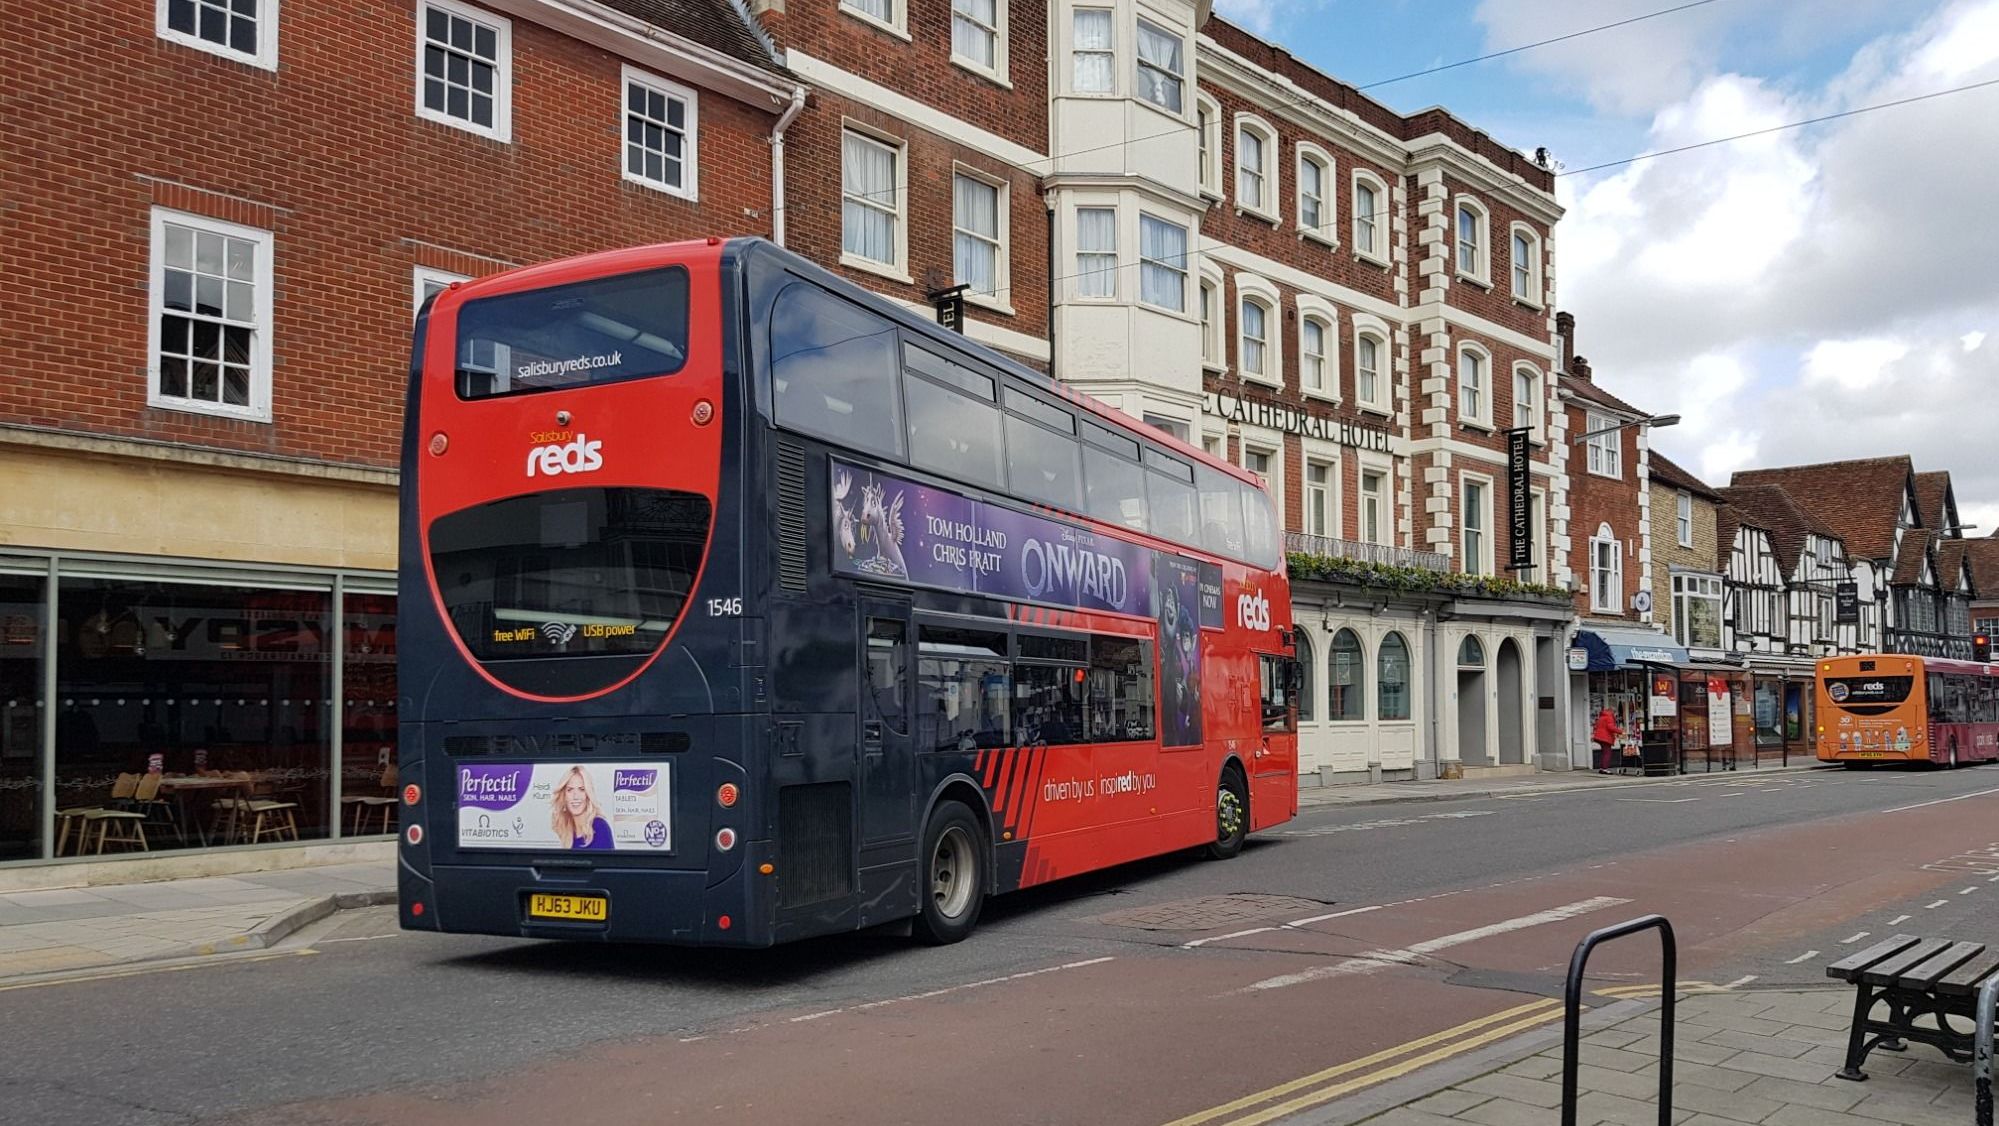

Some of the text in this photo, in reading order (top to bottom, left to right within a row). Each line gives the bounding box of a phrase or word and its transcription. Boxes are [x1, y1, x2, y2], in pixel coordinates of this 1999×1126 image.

[518, 350, 622, 378] salisburyreds.co.uk
[1217, 387, 1336, 441] CATHEDRAL
[1341, 416, 1396, 453] HOTEL
[530, 431, 574, 444] Salisbury
[527, 433, 603, 477] reds
[1513, 436, 1526, 560] THE CATHEDRAL HOTEL
[926, 514, 1007, 549] TOM HOLLAND
[933, 543, 1002, 575] CHRIS PRATT
[1022, 538, 1127, 610] ONWARD
[708, 598, 742, 617] 1546
[1203, 594, 1217, 609] NOW
[1237, 588, 1270, 632] reds
[494, 627, 535, 642] free WiFi
[583, 623, 635, 638] USB power
[1863, 681, 1884, 691] reds
[461, 768, 520, 796] Perfectil
[615, 771, 655, 788] Perfectil
[1044, 770, 1156, 803] driven by us inspired by you
[461, 828, 509, 838] VITABIOTICS
[537, 896, 600, 915] HJ63 JKU
